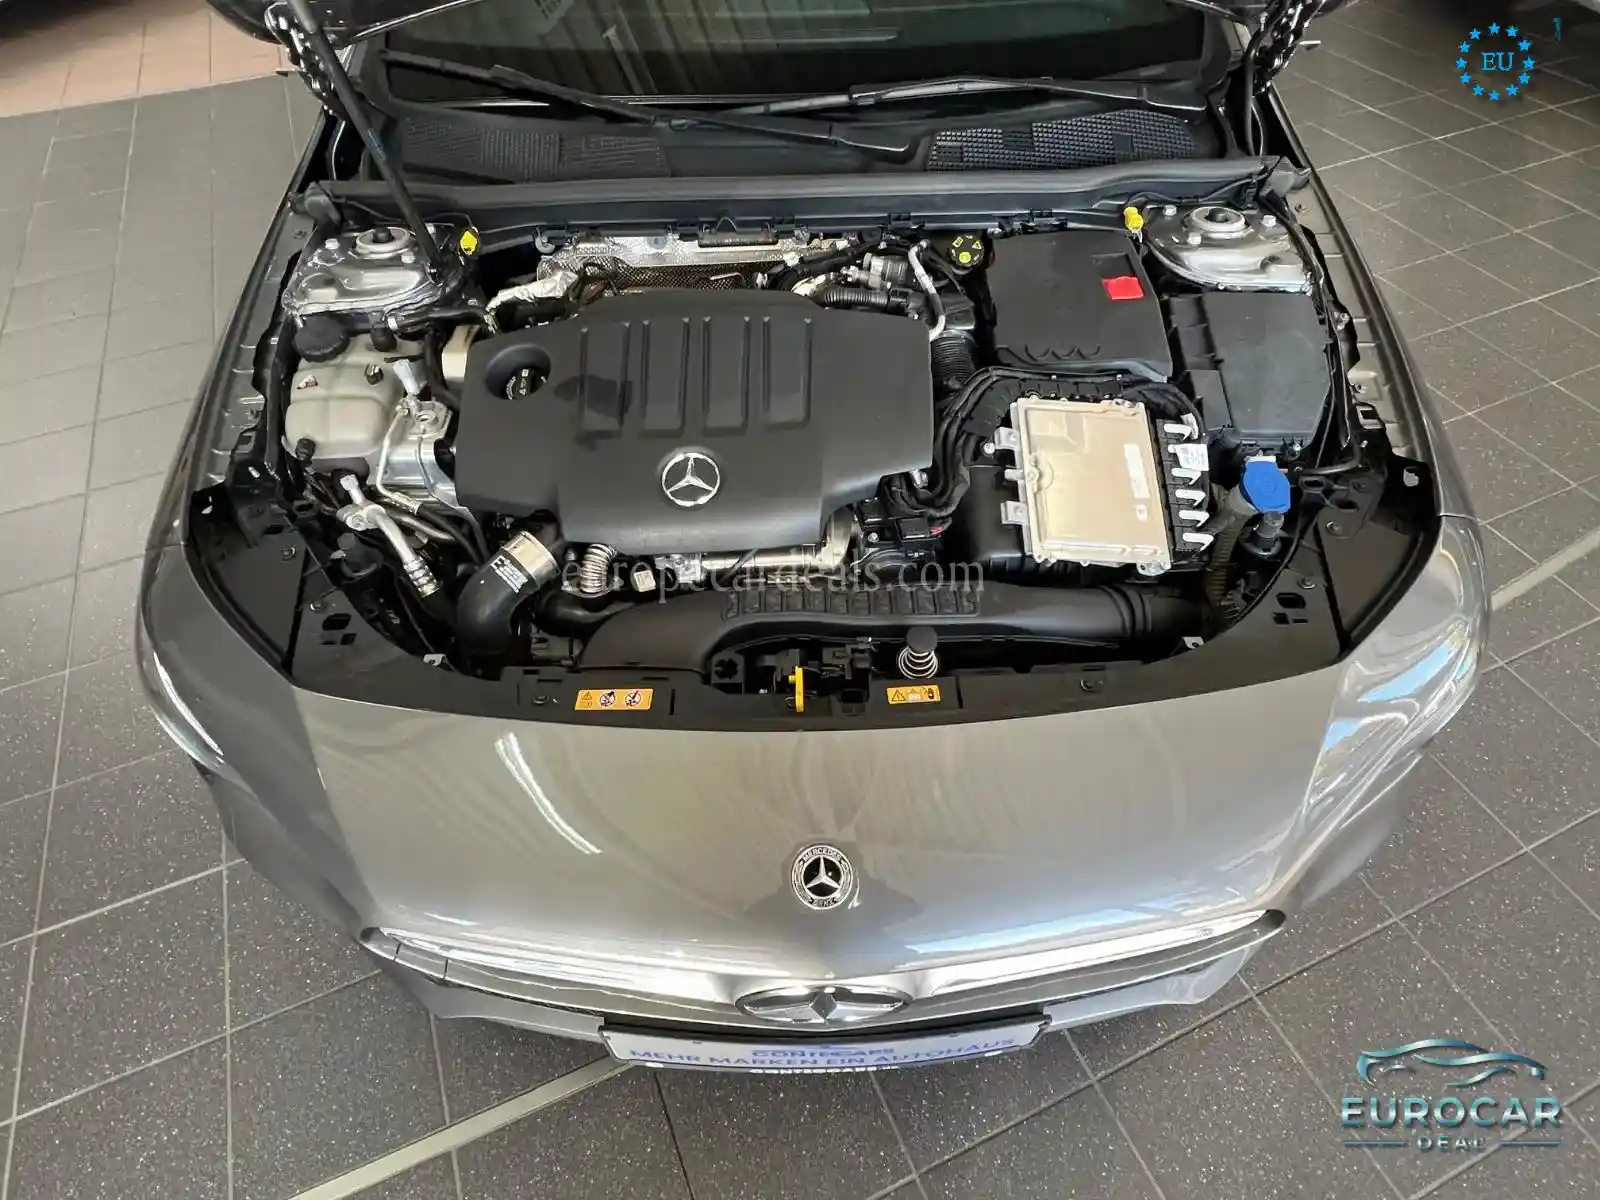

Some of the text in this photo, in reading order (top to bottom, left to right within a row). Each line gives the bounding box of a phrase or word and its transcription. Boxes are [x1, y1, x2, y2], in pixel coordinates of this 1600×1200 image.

[802, 847, 842, 862] MERCEDES
[629, 1038, 1016, 1066] MEHR MARKEN EIN AUTOHAUS
